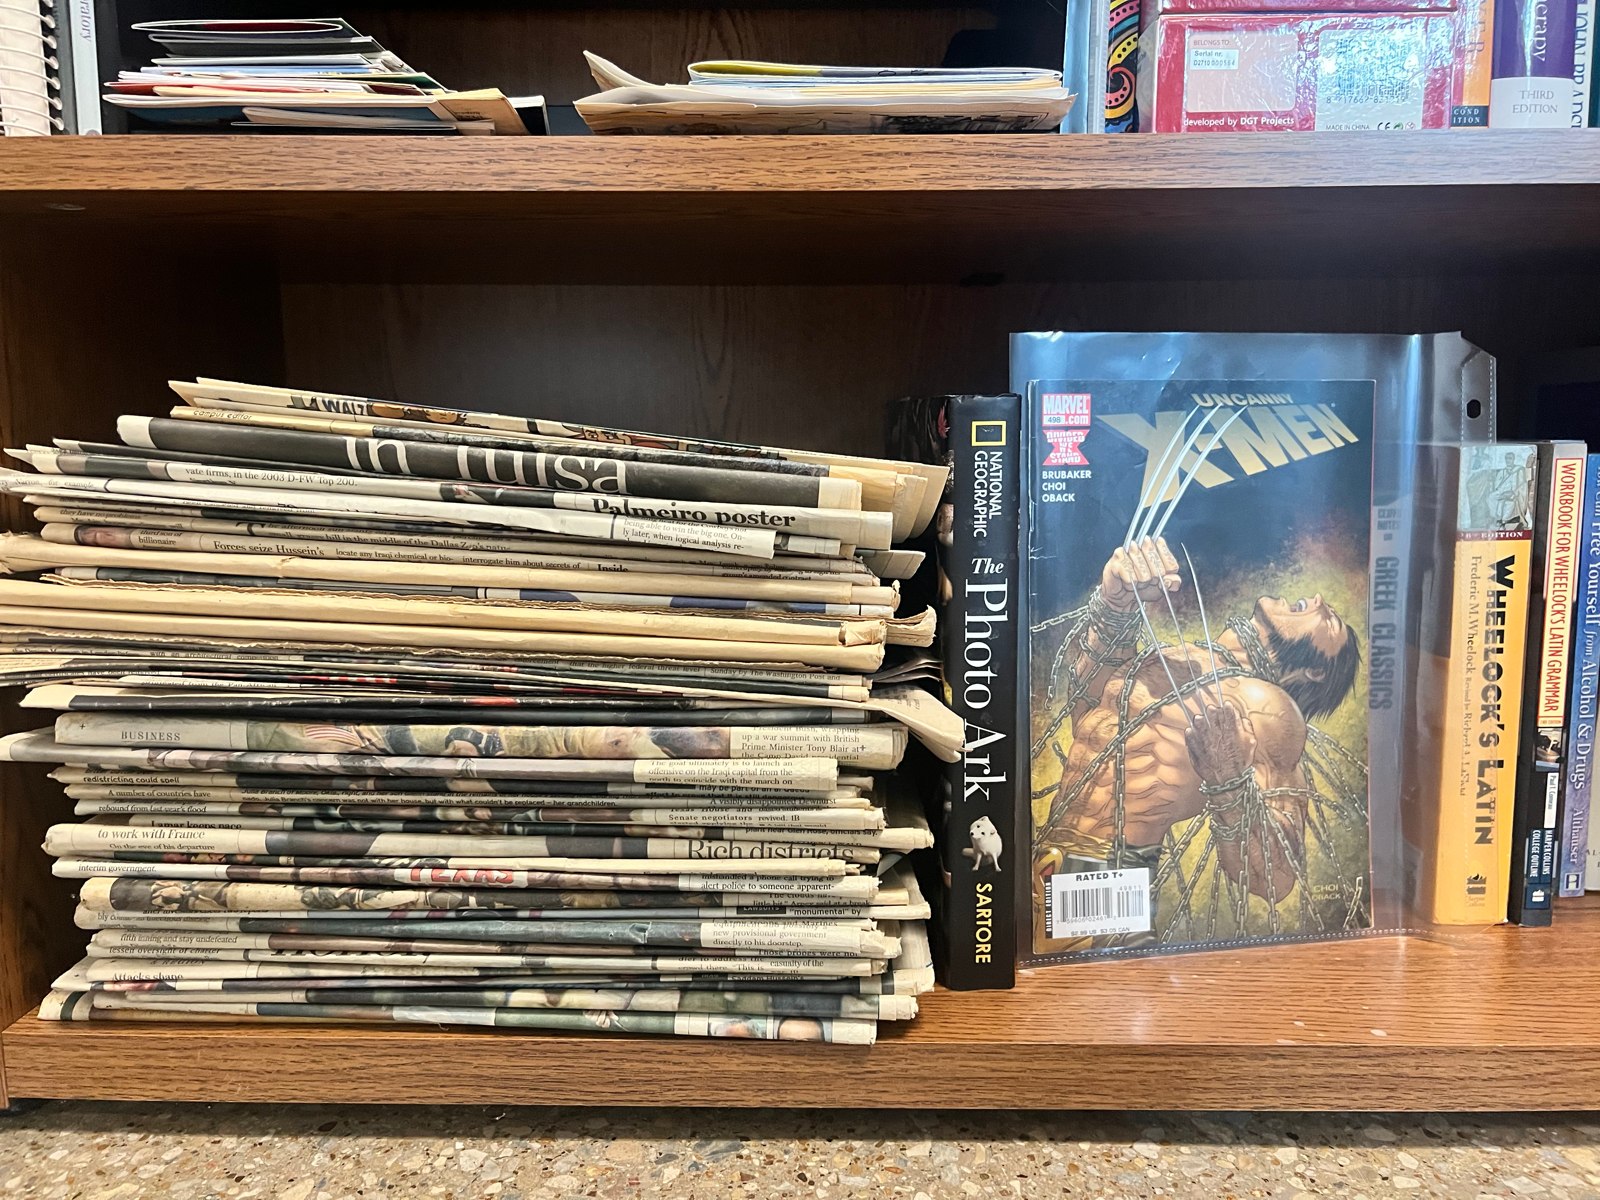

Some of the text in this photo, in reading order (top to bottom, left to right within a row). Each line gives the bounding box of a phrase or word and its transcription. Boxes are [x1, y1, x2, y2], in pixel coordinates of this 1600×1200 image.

[1520, 90, 1554, 100] THIRD
[1512, 104, 1558, 114] EDITION
[1183, 116, 1295, 129] developed by DGT Projects
[1043, 395, 1089, 414] MARVEL
[1190, 393, 1295, 408] UNCANNY
[193, 409, 224, 419] campus
[1047, 416, 1062, 424] 498
[1095, 402, 1360, 508] X-MEN
[186, 467, 204, 477] vate
[206, 468, 232, 479] firms,
[233, 470, 242, 479] in
[244, 470, 260, 480] the
[261, 472, 285, 482] 2003
[318, 476, 334, 487] Top
[336, 477, 358, 487] 200.
[1042, 470, 1092, 480] BRUBAKER
[988, 451, 1003, 519] NATIONAL
[1042, 482, 1067, 491] CHOI
[973, 450, 988, 538] GEOGRAPHIC
[1042, 493, 1076, 503] OBACK
[1556, 463, 1577, 531] WORKBOOK
[592, 498, 707, 522] Palmeiro
[714, 509, 797, 529] poster
[623, 518, 645, 531] being
[646, 521, 661, 531] able
[662, 523, 672, 532] to
[672, 525, 687, 534] win
[687, 526, 700, 536] the
[700, 527, 712, 540] big
[713, 531, 729, 539] one.
[730, 532, 746, 541] On-
[1480, 531, 1524, 539] EDITION
[138, 536, 178, 546] billionaire
[622, 527, 745, 550] ly later, when logical analysis re-
[1554, 532, 1571, 554] FOR
[213, 540, 325, 556] Forces seize Hussein's
[335, 548, 358, 557] locate
[359, 551, 373, 559] any
[374, 550, 393, 560] Iraqi
[394, 551, 428, 561] chemical
[439, 553, 454, 562] bio-
[462, 556, 582, 570] interrogate him about secrets of
[597, 563, 629, 572] Inside
[1373, 556, 1400, 611] GREEK
[1469, 556, 1482, 601] Frederic
[1550, 556, 1570, 624] WHEELOCK'S
[1548, 627, 1567, 657] LATIN
[1368, 622, 1397, 710] CLASSICS
[963, 557, 1008, 802] The Photo Ark
[1543, 660, 1564, 712] GRAMMAR
[1474, 554, 1517, 845] WHEELOCK'S LATIN
[1569, 523, 1600, 865] Free Yourself from Alcohol & Drugs Althauser
[121, 731, 181, 741] BUSINESS
[741, 734, 752, 742] up
[813, 735, 831, 743] with
[833, 735, 860, 743] British
[741, 743, 861, 753] Prime Minister Tony Blair at
[648, 767, 683, 776] offensive
[697, 767, 710, 776] the
[712, 768, 730, 778] Iraqi
[732, 768, 758, 778] capital
[760, 768, 779, 776] from
[780, 768, 793, 776] the
[115, 790, 147, 798] number
[149, 790, 157, 798] of
[156, 790, 192, 798] countries
[193, 790, 211, 798] have
[669, 814, 753, 823] Senate negotiators
[98, 828, 206, 840] to work with France
[688, 840, 855, 860] Rich districts
[1530, 830, 1541, 877] COLLEGE OUTLINE
[78, 864, 157, 874] interim government.
[1076, 873, 1109, 881] RATED
[701, 881, 720, 889] alert
[721, 881, 747, 891] police
[758, 882, 795, 890] someone
[797, 883, 835, 892] apparent-
[1313, 883, 1339, 892] CHOI
[975, 883, 993, 964] SARTORE
[713, 929, 827, 940] new provisional government
[712, 939, 743, 949] directly
[744, 940, 753, 948] to
[754, 940, 765, 948] his
[770, 959, 824, 969] casualty of the
